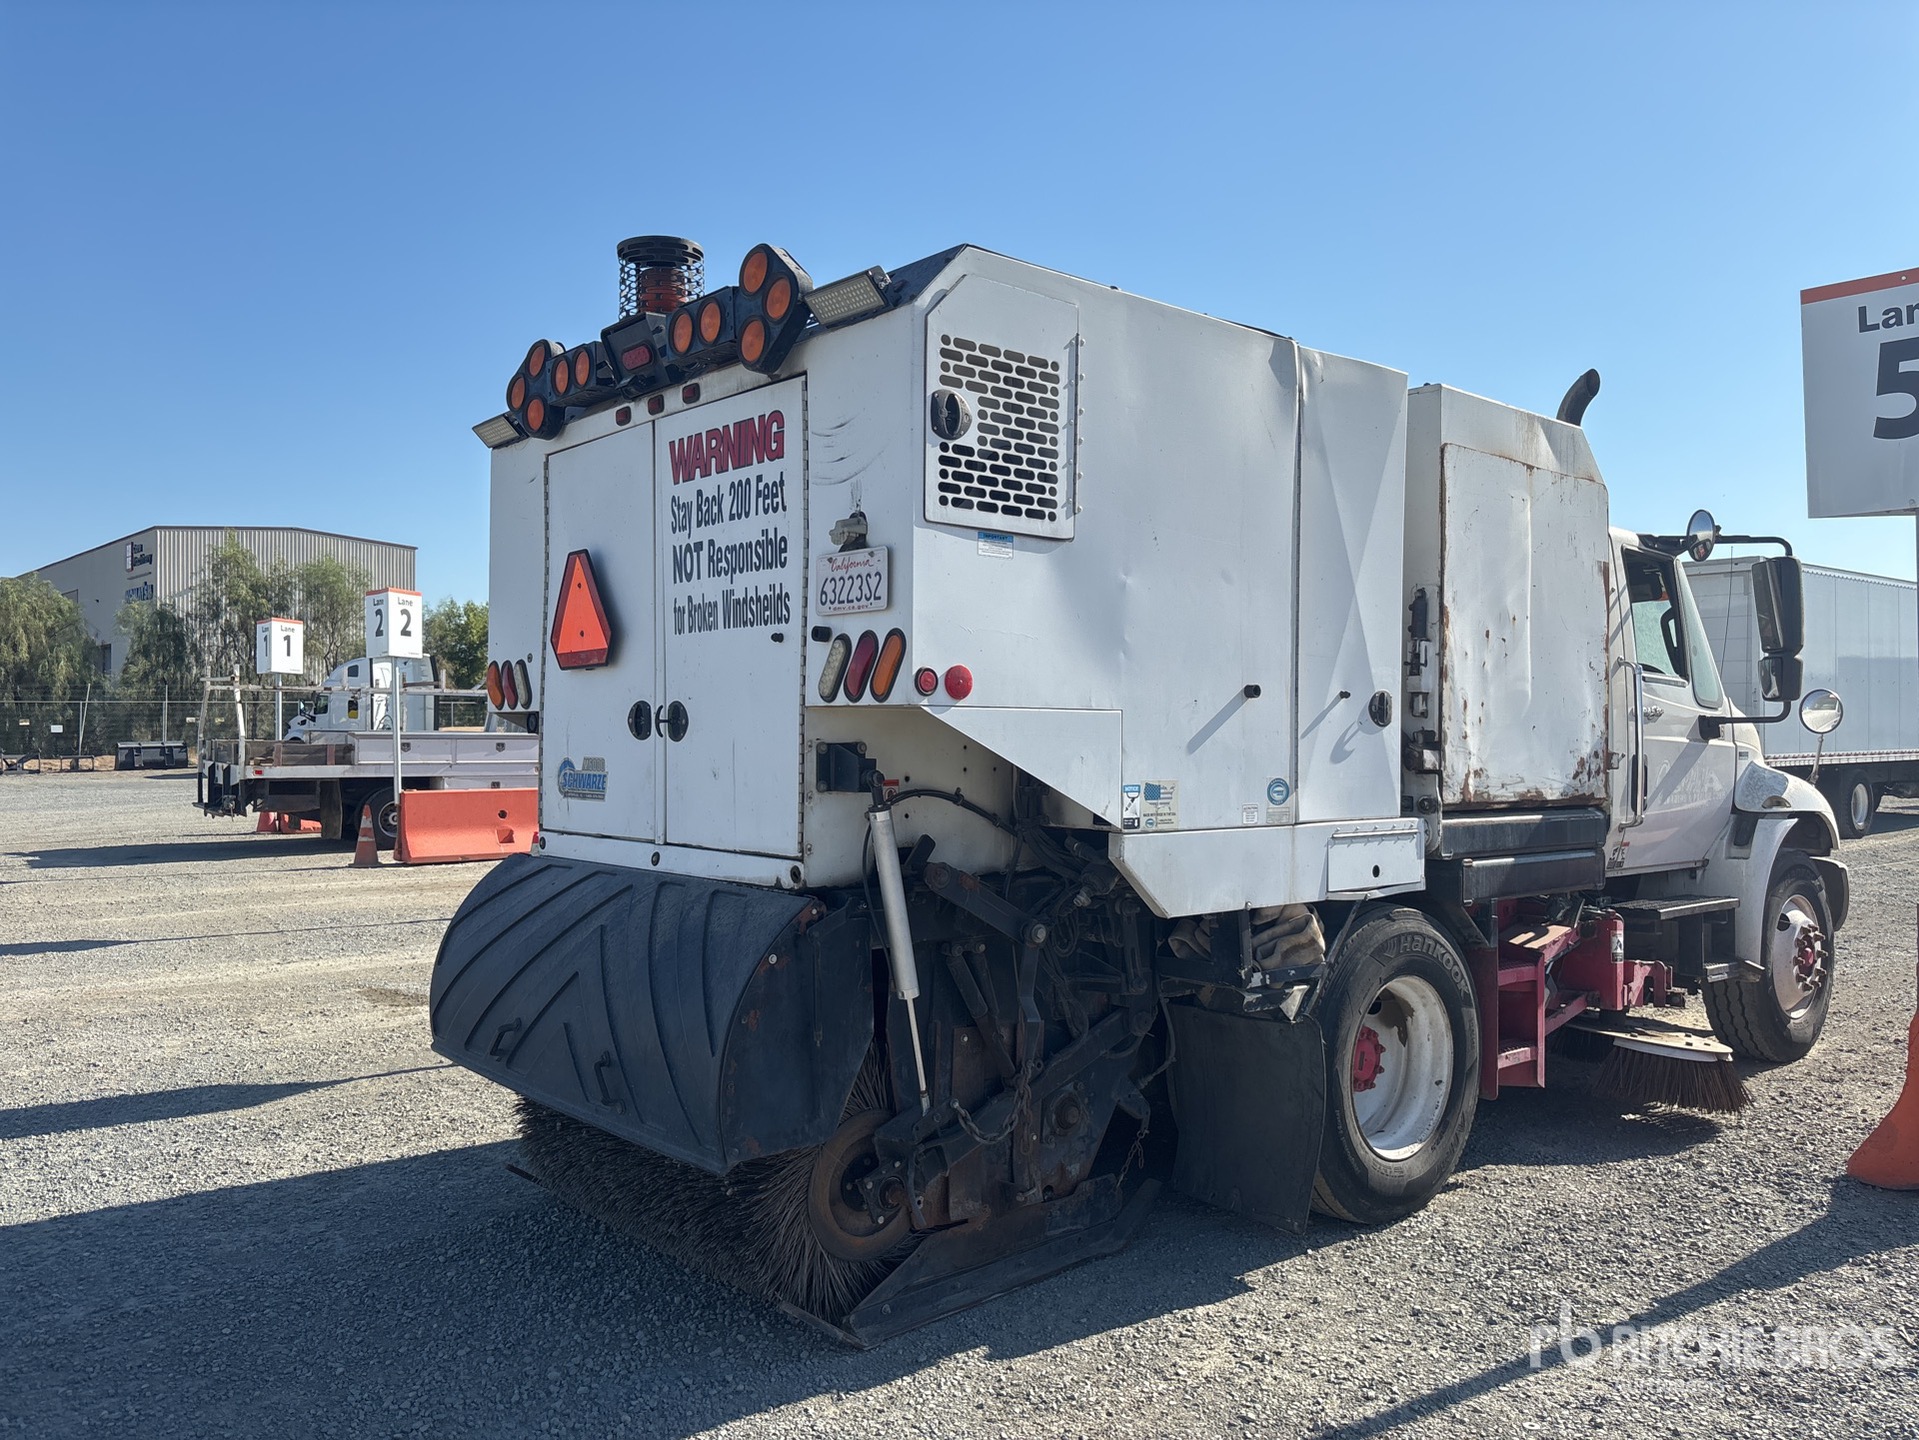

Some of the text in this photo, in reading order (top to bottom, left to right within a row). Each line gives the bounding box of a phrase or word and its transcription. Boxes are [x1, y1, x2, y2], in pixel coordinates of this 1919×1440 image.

[1873, 337, 1919, 440] 5
[669, 410, 785, 485] WARNING
[671, 471, 787, 539] Stay Back 200 Feet
[672, 527, 788, 584] NOT Responsible
[831, 556, 874, 574] California
[397, 597, 413, 606] Lane
[820, 571, 882, 606] 63223S2
[375, 608, 384, 637] 2
[400, 608, 412, 637] 2
[673, 582, 790, 635] for Broken Windsheilds
[280, 624, 295, 633] Lane
[263, 634, 268, 657] 1
[283, 634, 291, 657] 1
[563, 771, 607, 791] SCHWARZE
